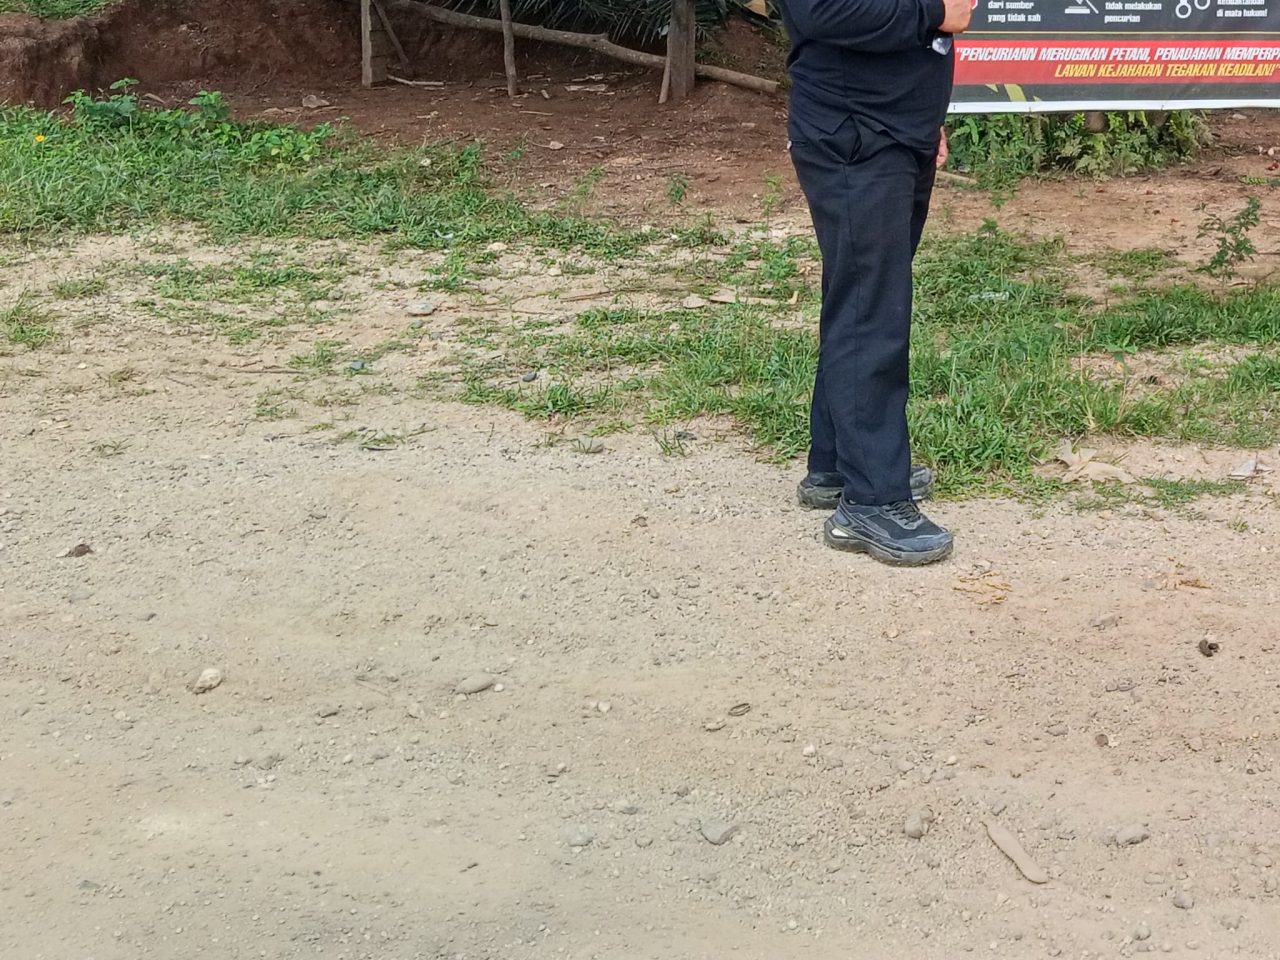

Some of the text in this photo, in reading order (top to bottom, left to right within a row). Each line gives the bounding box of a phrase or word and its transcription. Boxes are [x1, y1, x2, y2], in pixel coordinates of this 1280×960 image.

[1038, 47, 1107, 61] MERUGIKAN
[1109, 47, 1151, 62] PETANI,
[1153, 47, 1221, 61] PENADAHAN
[1055, 64, 1096, 78] LAWAN
[1098, 64, 1163, 77] KEJAHATAN
[1166, 64, 1216, 77] TEGAKAN
